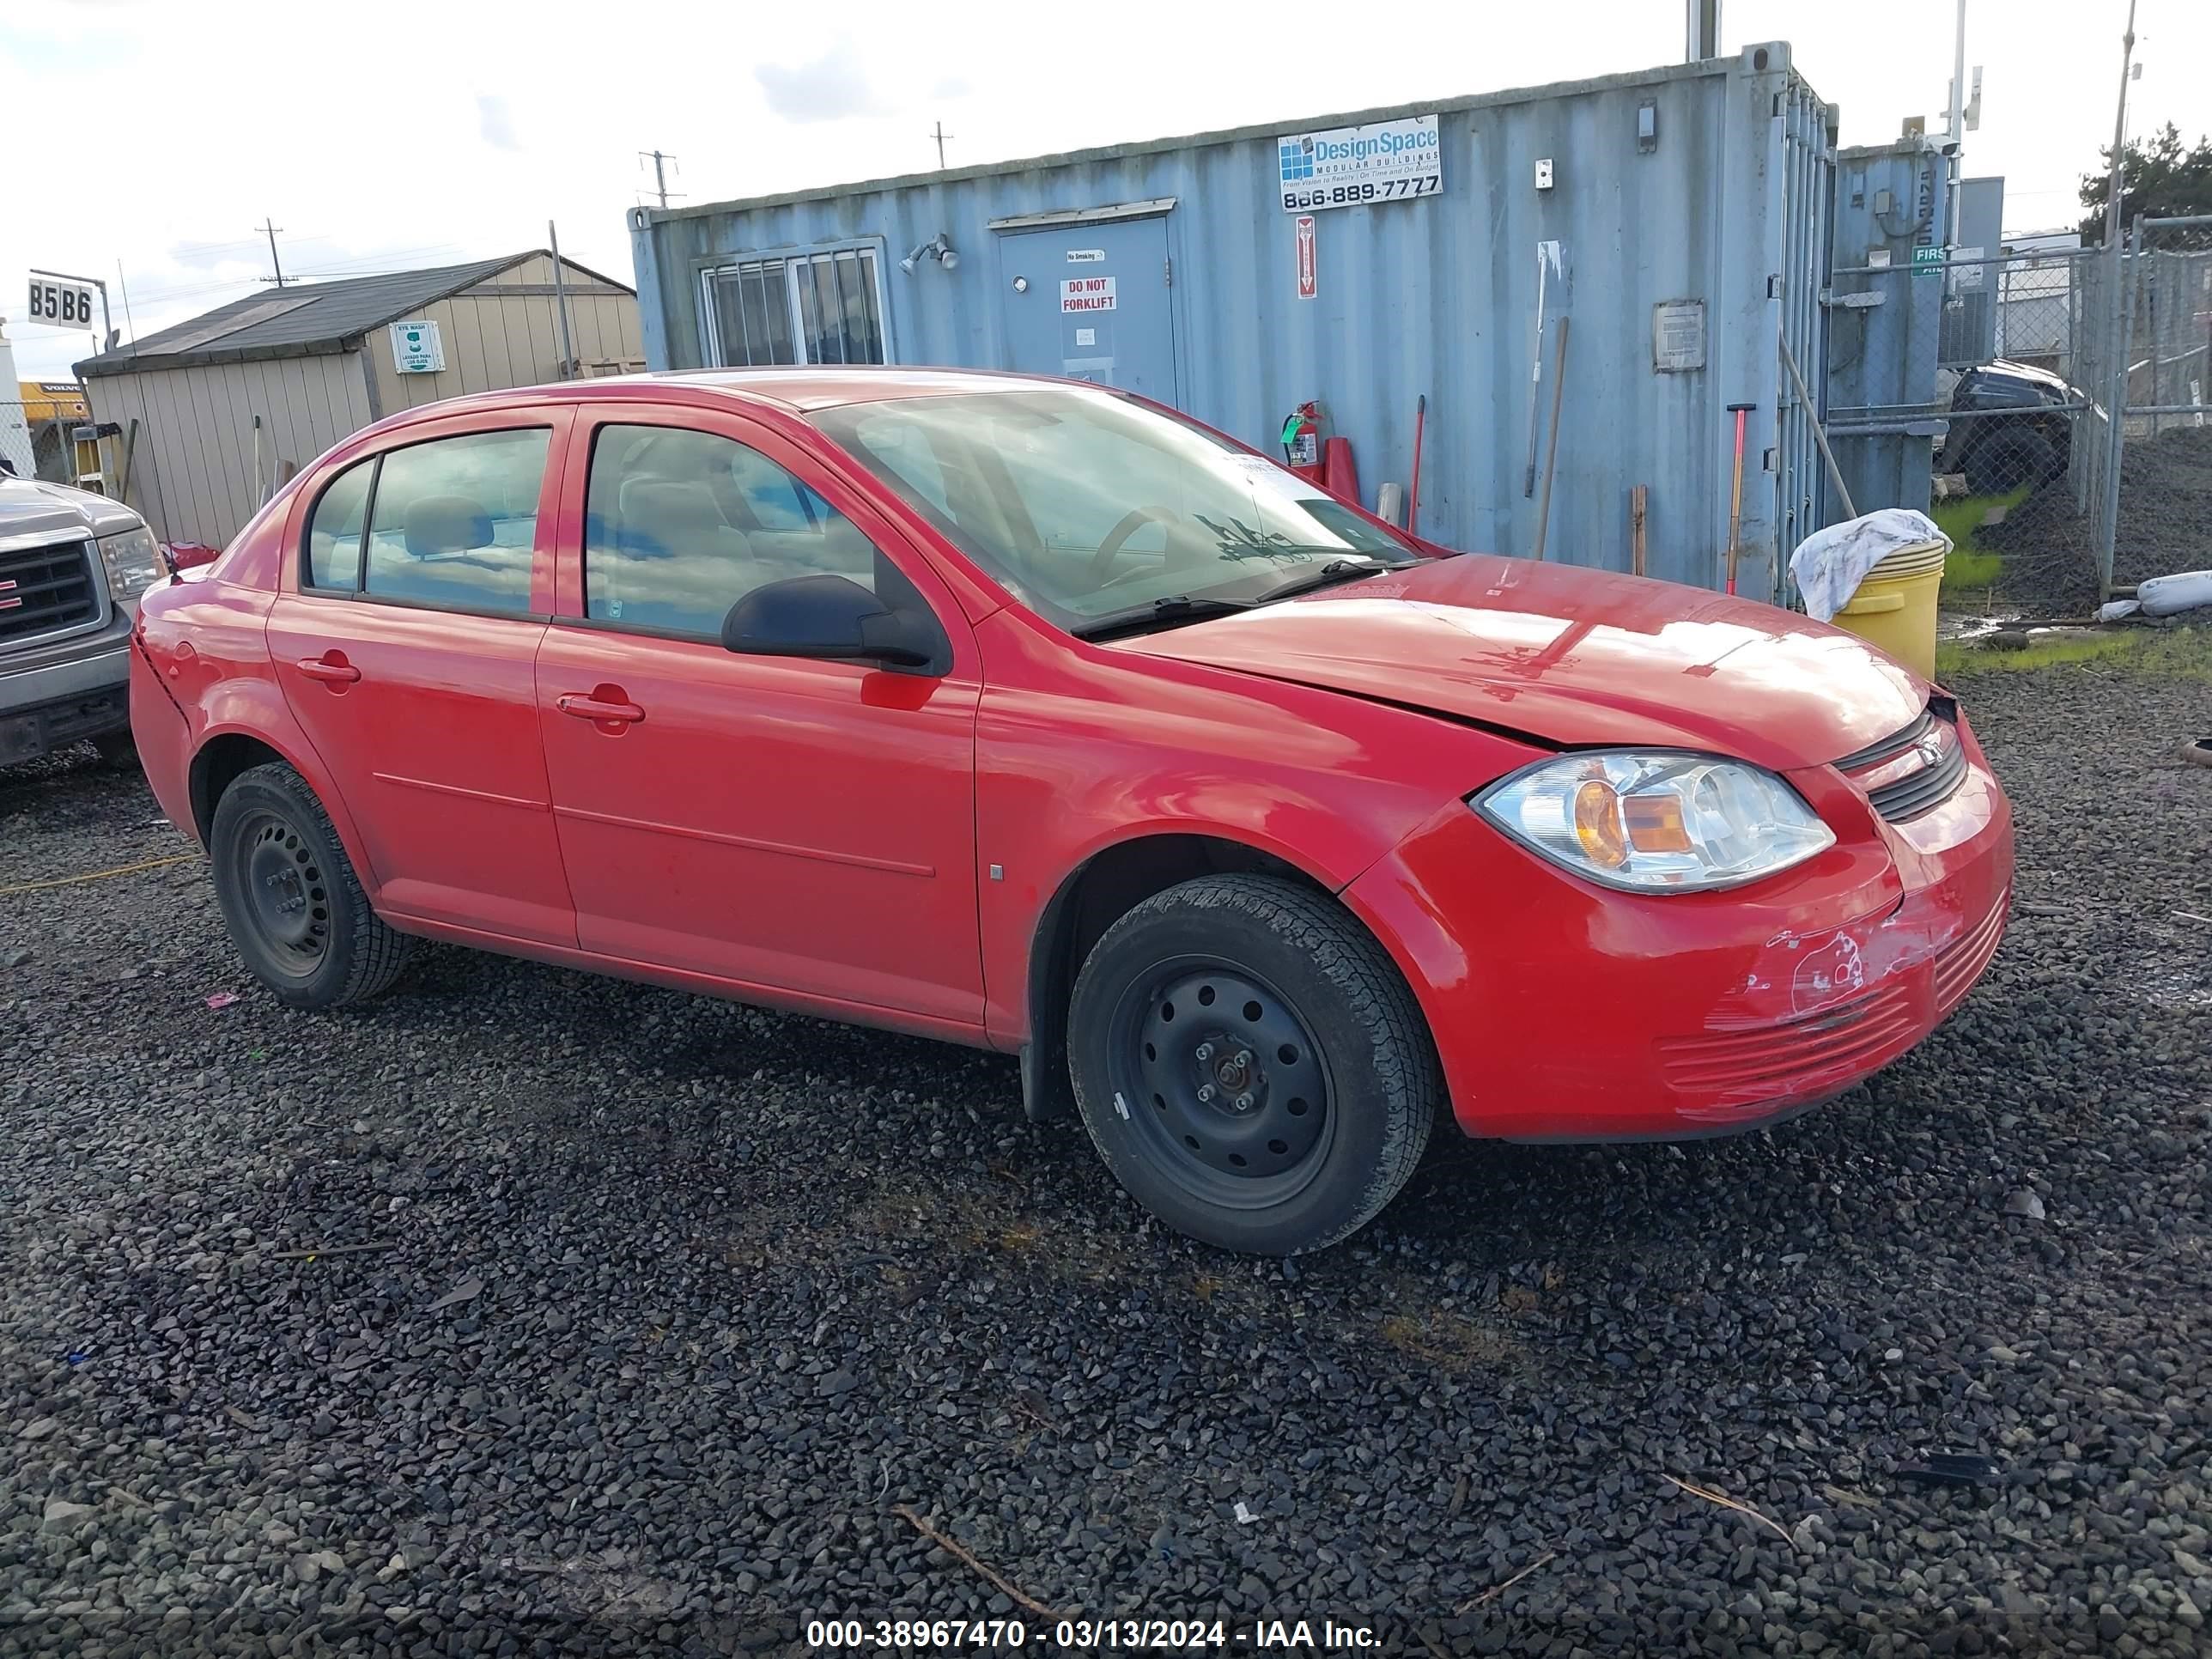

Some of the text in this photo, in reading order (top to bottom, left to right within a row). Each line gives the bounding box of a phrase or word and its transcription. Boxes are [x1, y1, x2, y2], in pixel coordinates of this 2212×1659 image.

[1316, 130, 1437, 161] DesignSpace
[1317, 151, 1438, 174] MODULAR BUILDINGS
[1302, 174, 1322, 186] Vision
[1323, 174, 1330, 183] to
[1332, 173, 1355, 182] Reality
[1372, 169, 1388, 178] Time
[1389, 167, 1402, 176] and
[1285, 175, 1439, 209] 866-889-7777
[1076, 252, 1095, 260] Smoking
[1917, 247, 1944, 261] FIRS
[1069, 279, 1107, 293] DO NOT
[30, 284, 91, 324] B5 B6
[1063, 296, 1115, 311] FORKLIFT
